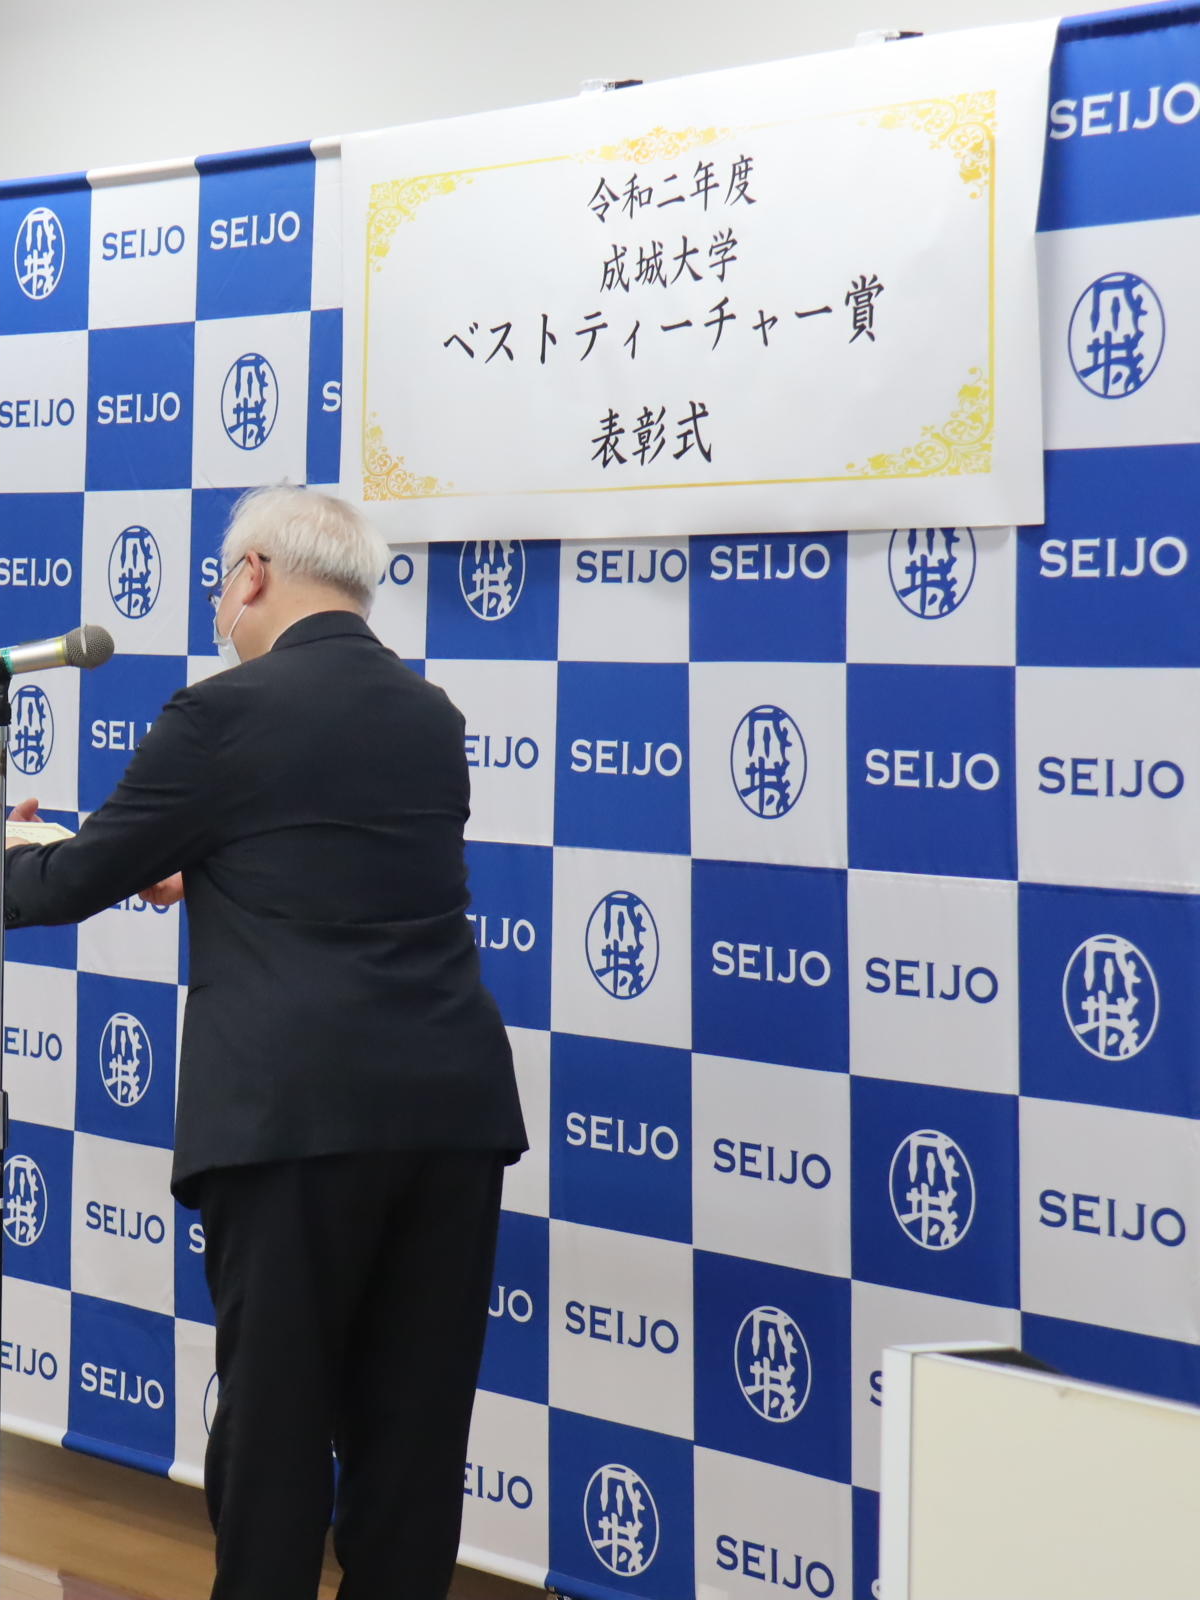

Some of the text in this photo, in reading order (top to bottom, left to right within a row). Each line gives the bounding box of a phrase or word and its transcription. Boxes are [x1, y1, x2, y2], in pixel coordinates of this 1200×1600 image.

[1050, 82, 1200, 139] SEIJO
[588, 155, 756, 223] 令和二年度
[102, 225, 185, 261] SEIJO
[210, 211, 300, 250] SEIJO
[600, 228, 737, 292] 成城大学
[443, 274, 884, 364] ベストティーチャー賞
[0, 398, 74, 428] SEIJO
[98, 392, 180, 424] SEIJO
[592, 401, 712, 468] 表彰式
[577, 549, 687, 583] SEIJO
[711, 544, 830, 580] SEIJO
[1040, 537, 1187, 578] SEIJO
[92, 720, 152, 750] SEI
[464, 735, 539, 769] EIJO
[571, 739, 682, 776] SEIJO
[866, 749, 999, 790] SEIJO
[1039, 757, 1184, 799] SEIJO
[465, 914, 535, 951] IJO
[712, 941, 830, 986] SEIJO
[866, 957, 998, 1004] SEIJO
[567, 1112, 678, 1160] SEIJO
[714, 1138, 831, 1189] SEIJO
[86, 1201, 165, 1244] SEIJO
[1039, 1190, 1185, 1247] SEIJO
[566, 1301, 679, 1354] SEIJO
[81, 1362, 164, 1409] SEIJO
[464, 1463, 533, 1509] IJO
[717, 1535, 834, 1598] SEIJO
